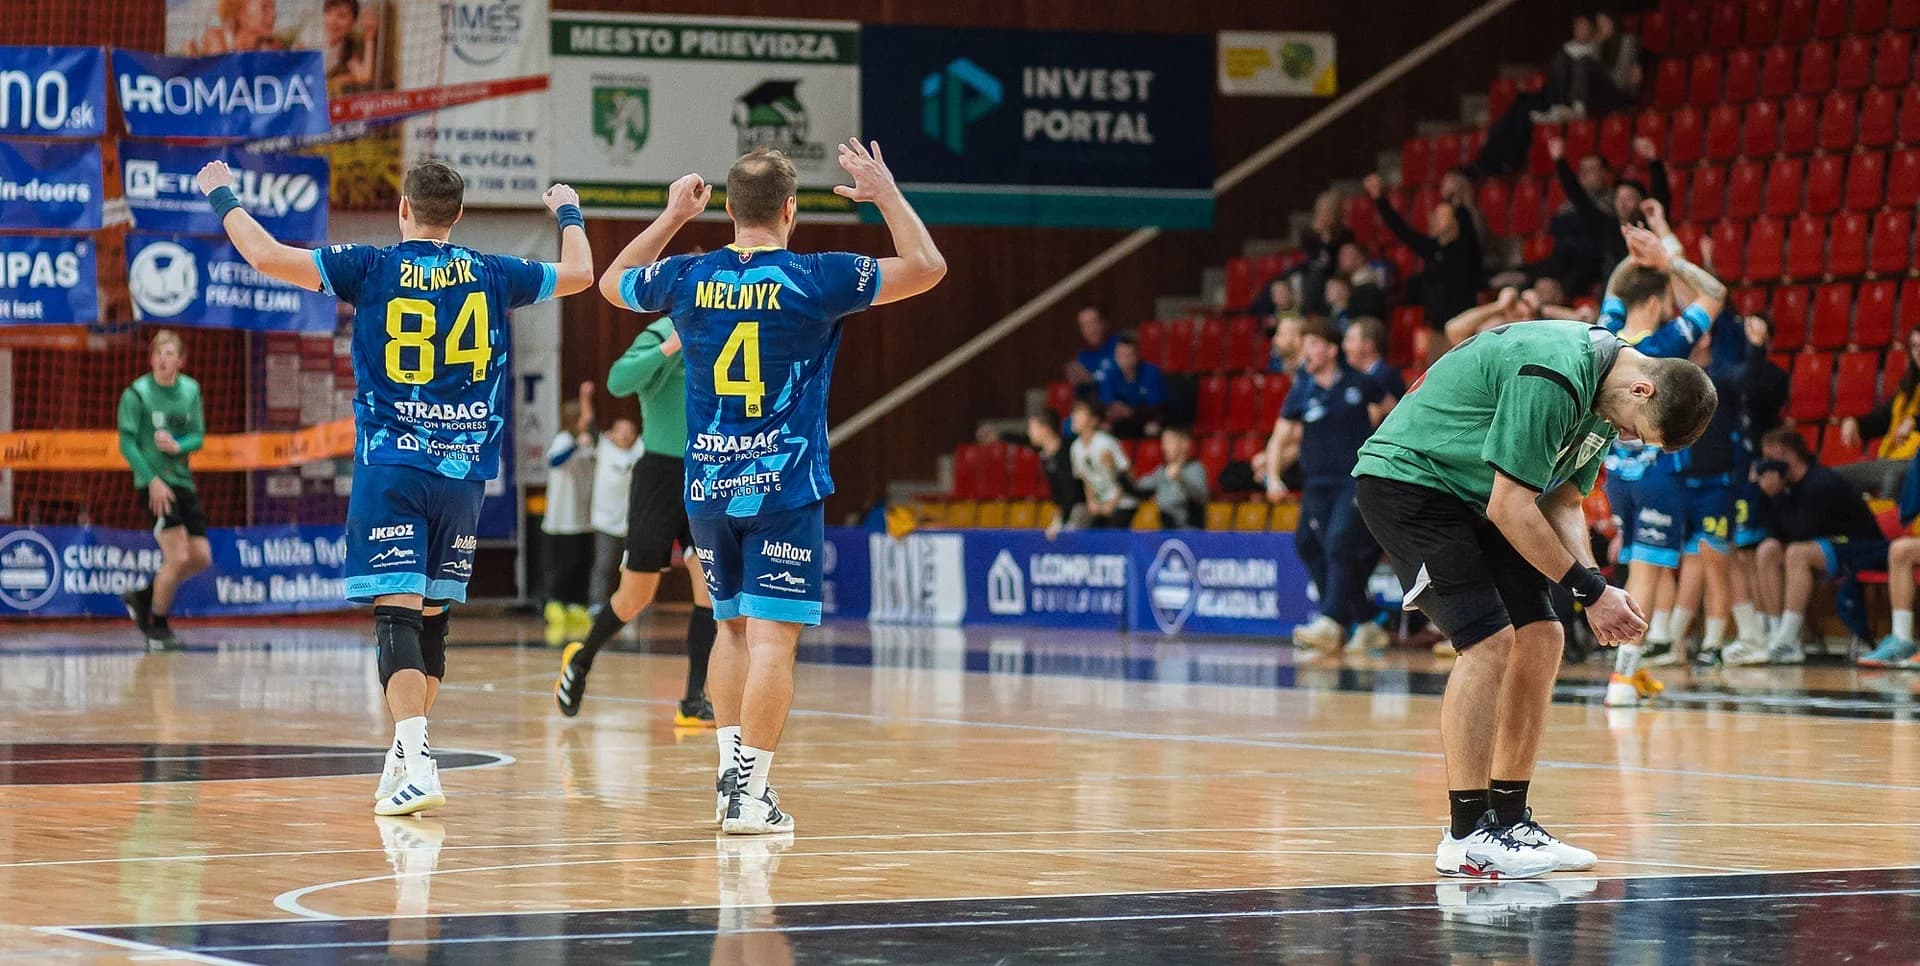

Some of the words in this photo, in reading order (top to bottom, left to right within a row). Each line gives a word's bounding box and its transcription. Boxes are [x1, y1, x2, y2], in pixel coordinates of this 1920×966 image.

[439, 4, 522, 31] TIMES
[570, 26, 673, 51] MESTO
[680, 30, 838, 59] PRIEVIDZA
[119, 73, 314, 115] HROMADA
[1022, 67, 1154, 99] INVEST
[415, 127, 537, 142] INTERNET
[1022, 110, 1154, 144] PORTAL
[695, 280, 782, 310] MELNYK
[385, 291, 492, 385] 84
[713, 321, 765, 418] 4
[394, 401, 488, 420] STRABAG
[424, 420, 438, 429] ON
[441, 421, 487, 431] PROGRESS
[692, 452, 716, 463] WORK
[711, 472, 780, 490] LCOMPLETE
[711, 484, 782, 499] BUILDING
[236, 538, 262, 568] Tu
[761, 540, 812, 562] JobRoxx
[269, 571, 346, 603] Reklam
